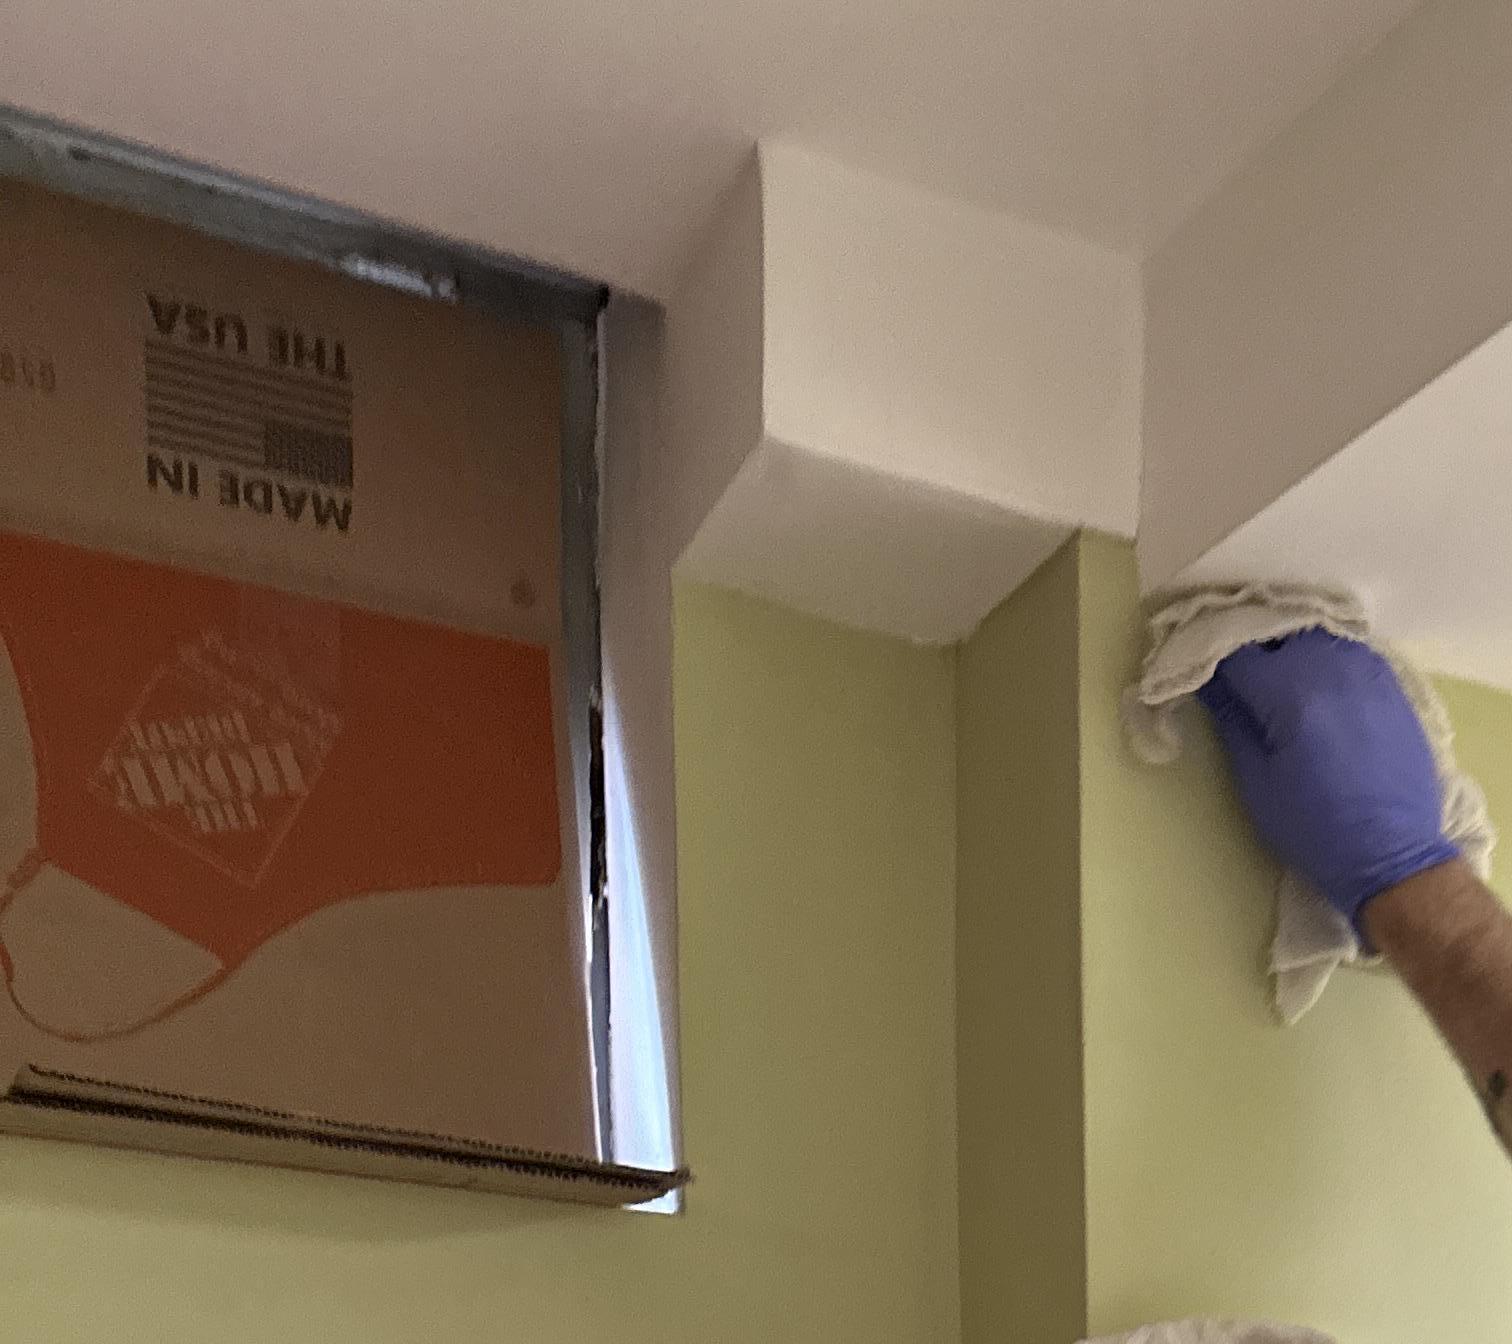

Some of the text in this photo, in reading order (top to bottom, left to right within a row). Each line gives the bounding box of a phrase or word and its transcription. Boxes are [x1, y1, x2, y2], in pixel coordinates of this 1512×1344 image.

[146, 295, 347, 382] THE USA
[146, 454, 352, 532] MADE IN
